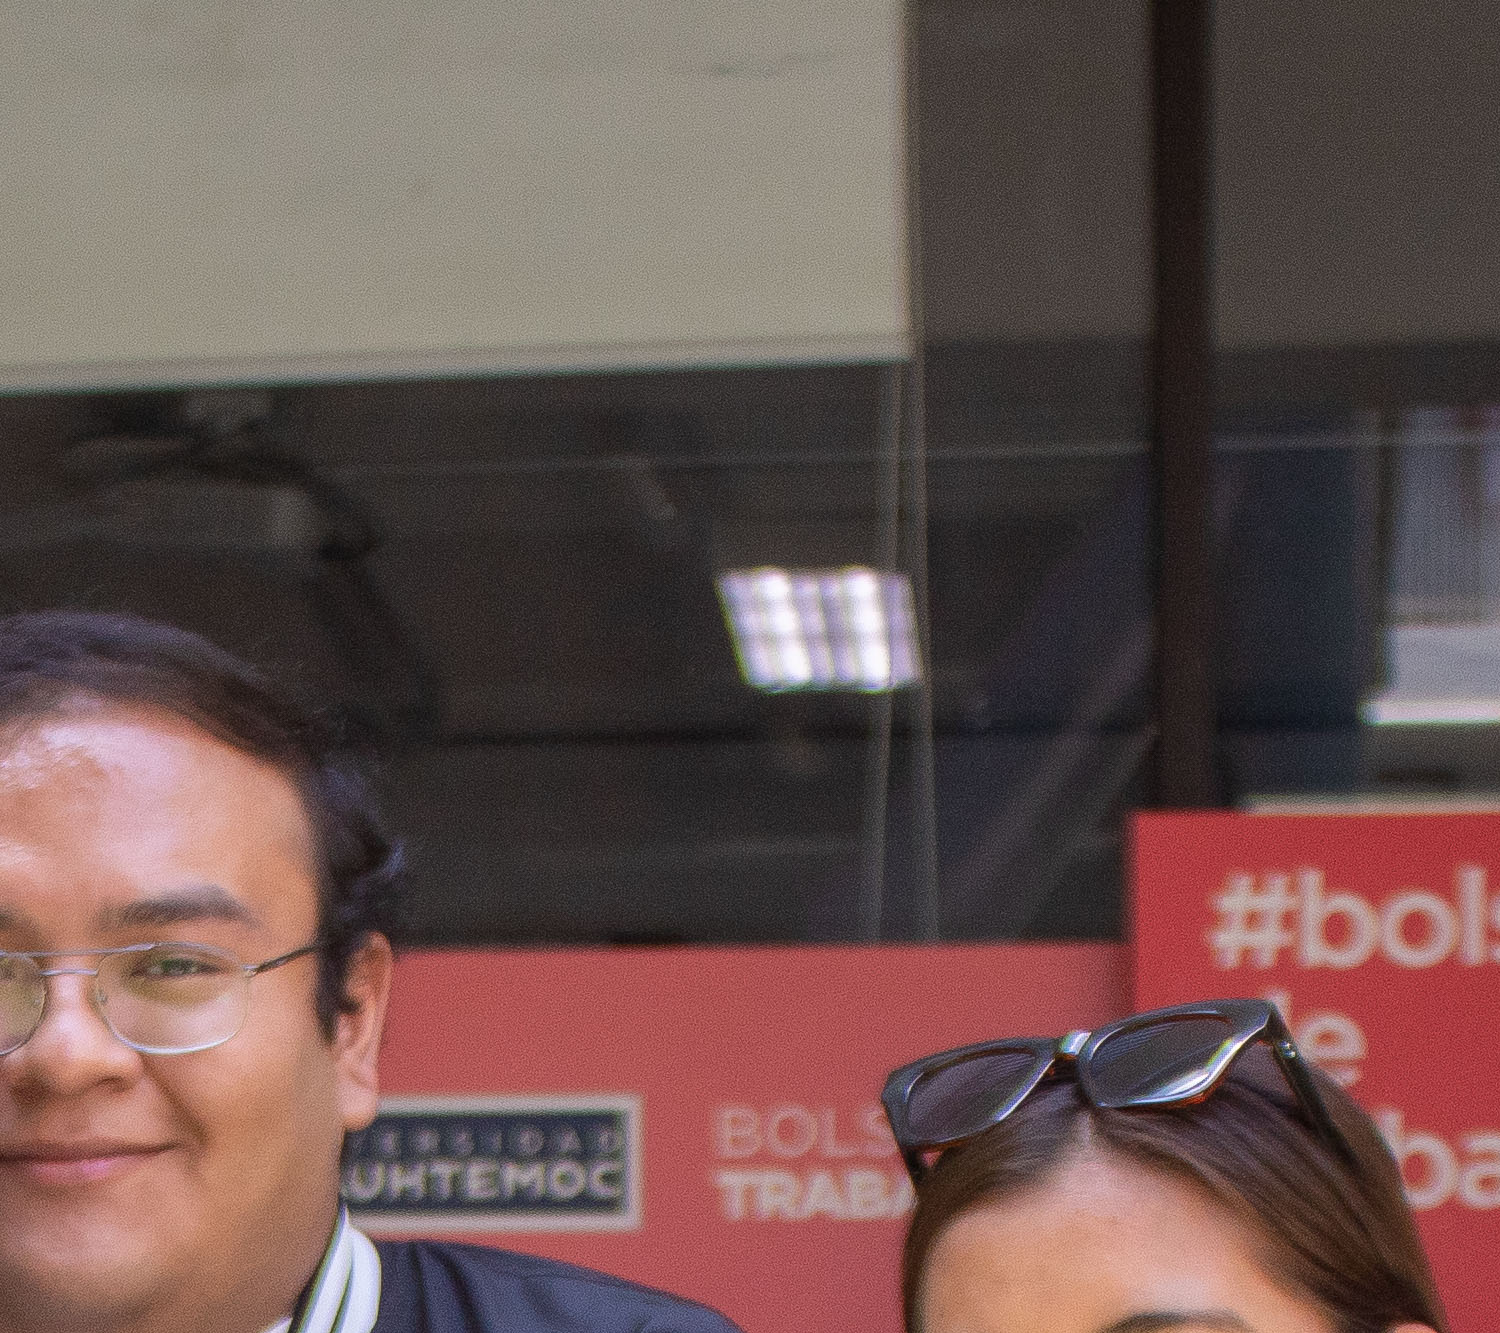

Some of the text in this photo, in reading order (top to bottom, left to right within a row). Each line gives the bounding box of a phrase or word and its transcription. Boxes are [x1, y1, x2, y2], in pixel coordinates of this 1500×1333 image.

[1262, 986, 1368, 1087] e
[716, 1106, 900, 1158] BOLS
[343, 1160, 622, 1203] UHTEMOC
[716, 1168, 917, 1221] TRABA
